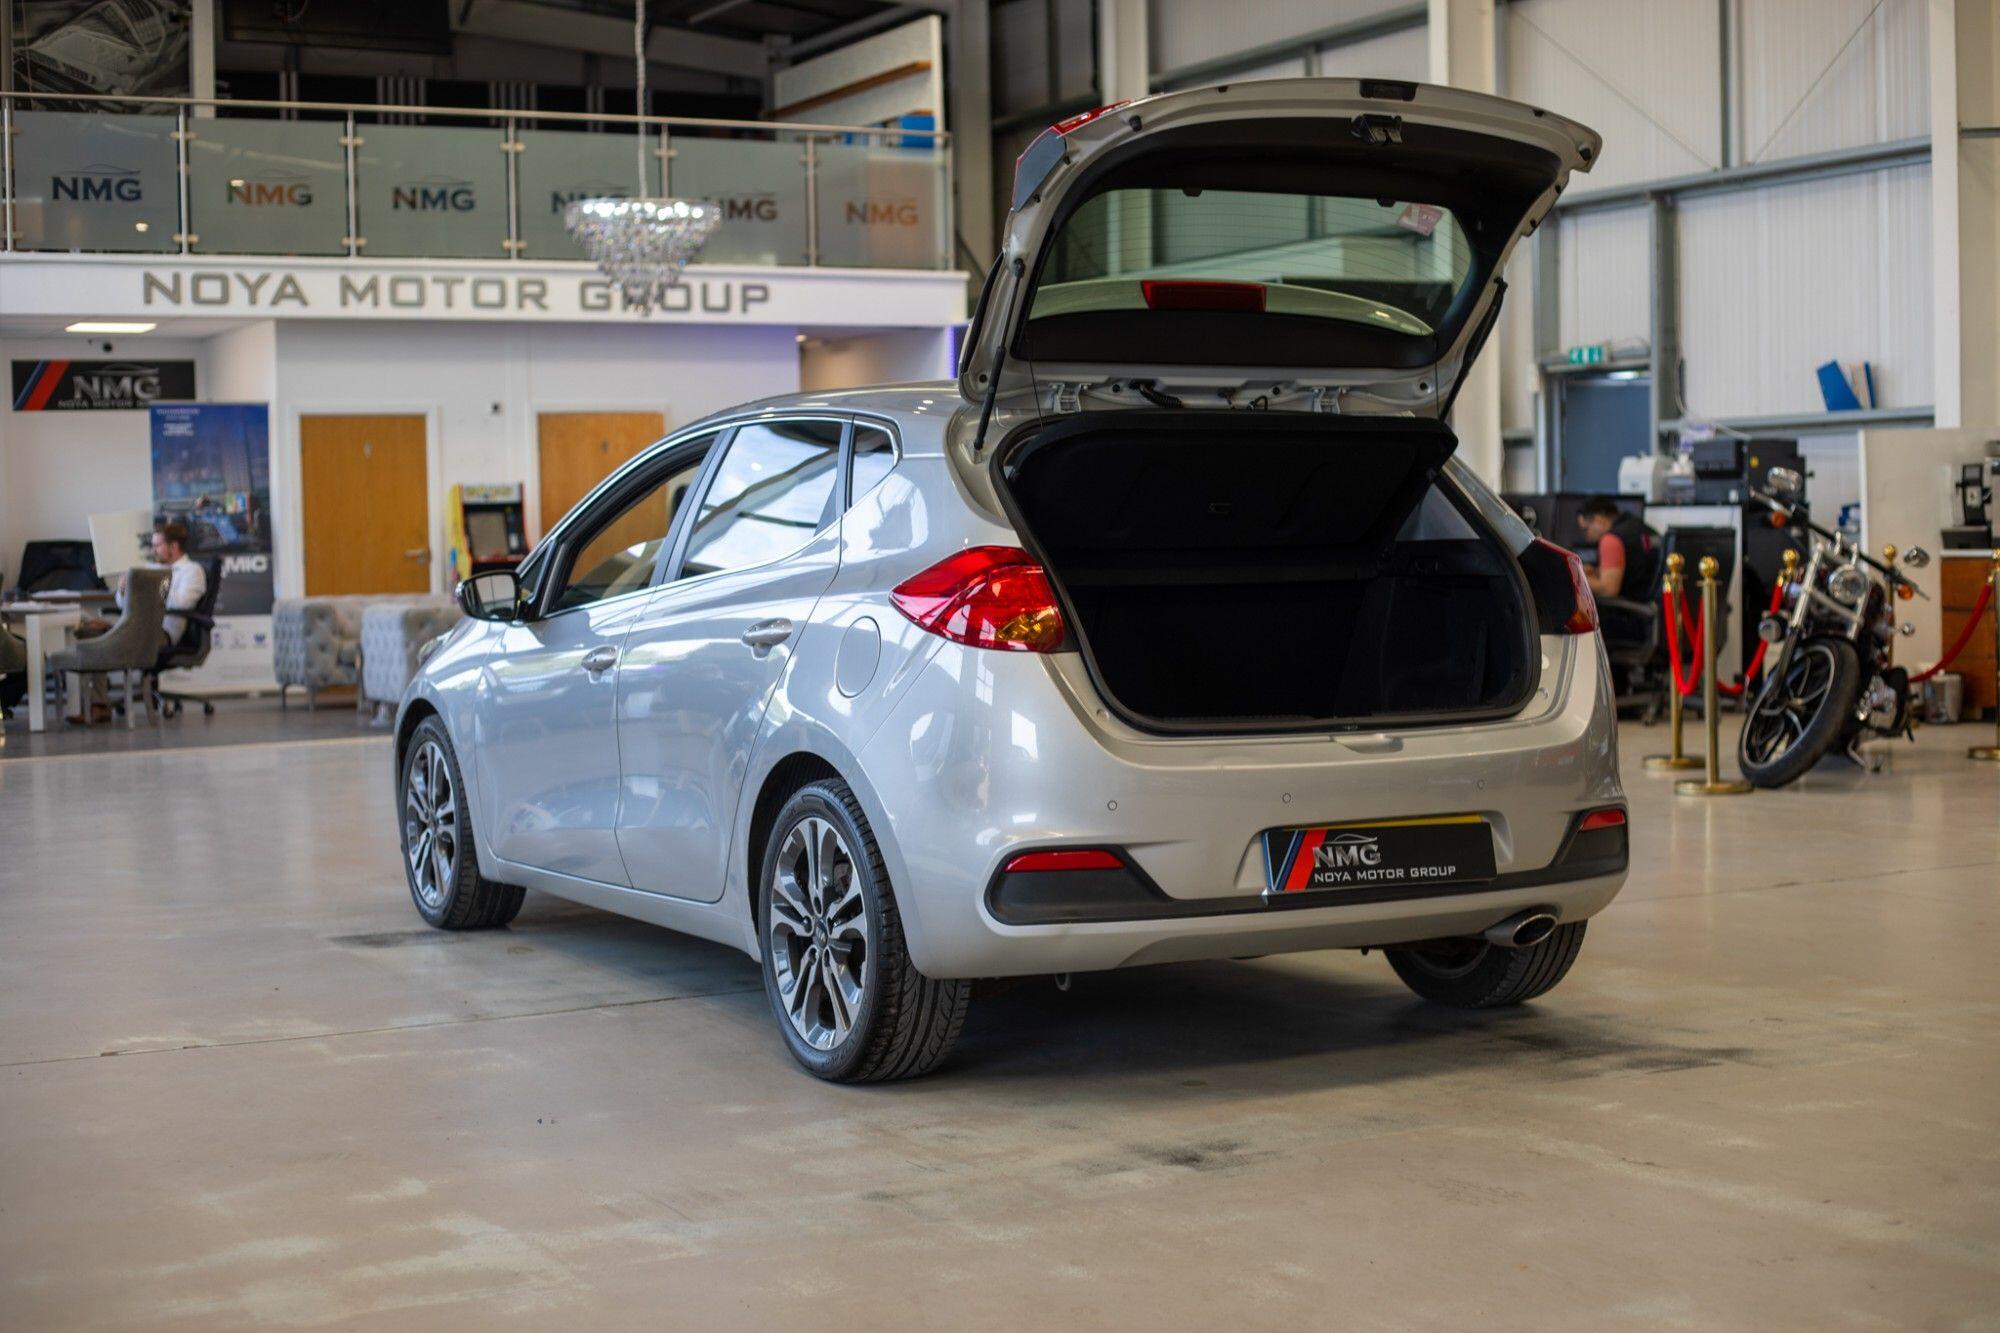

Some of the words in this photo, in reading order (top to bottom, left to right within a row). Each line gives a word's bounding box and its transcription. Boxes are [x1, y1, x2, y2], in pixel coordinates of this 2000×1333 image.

[52, 176, 142, 202] NMG
[227, 181, 314, 207] NMG
[392, 187, 476, 212] NMG
[845, 200, 920, 226] NMG
[143, 271, 309, 307] NOYA
[340, 274, 550, 311] MOTOR
[72, 376, 162, 399] NMG
[1312, 843, 1382, 868] NMG
[1314, 870, 1351, 883] NOYA
[1356, 867, 1405, 881] MOTOR
[1410, 865, 1456, 878] GROUP
